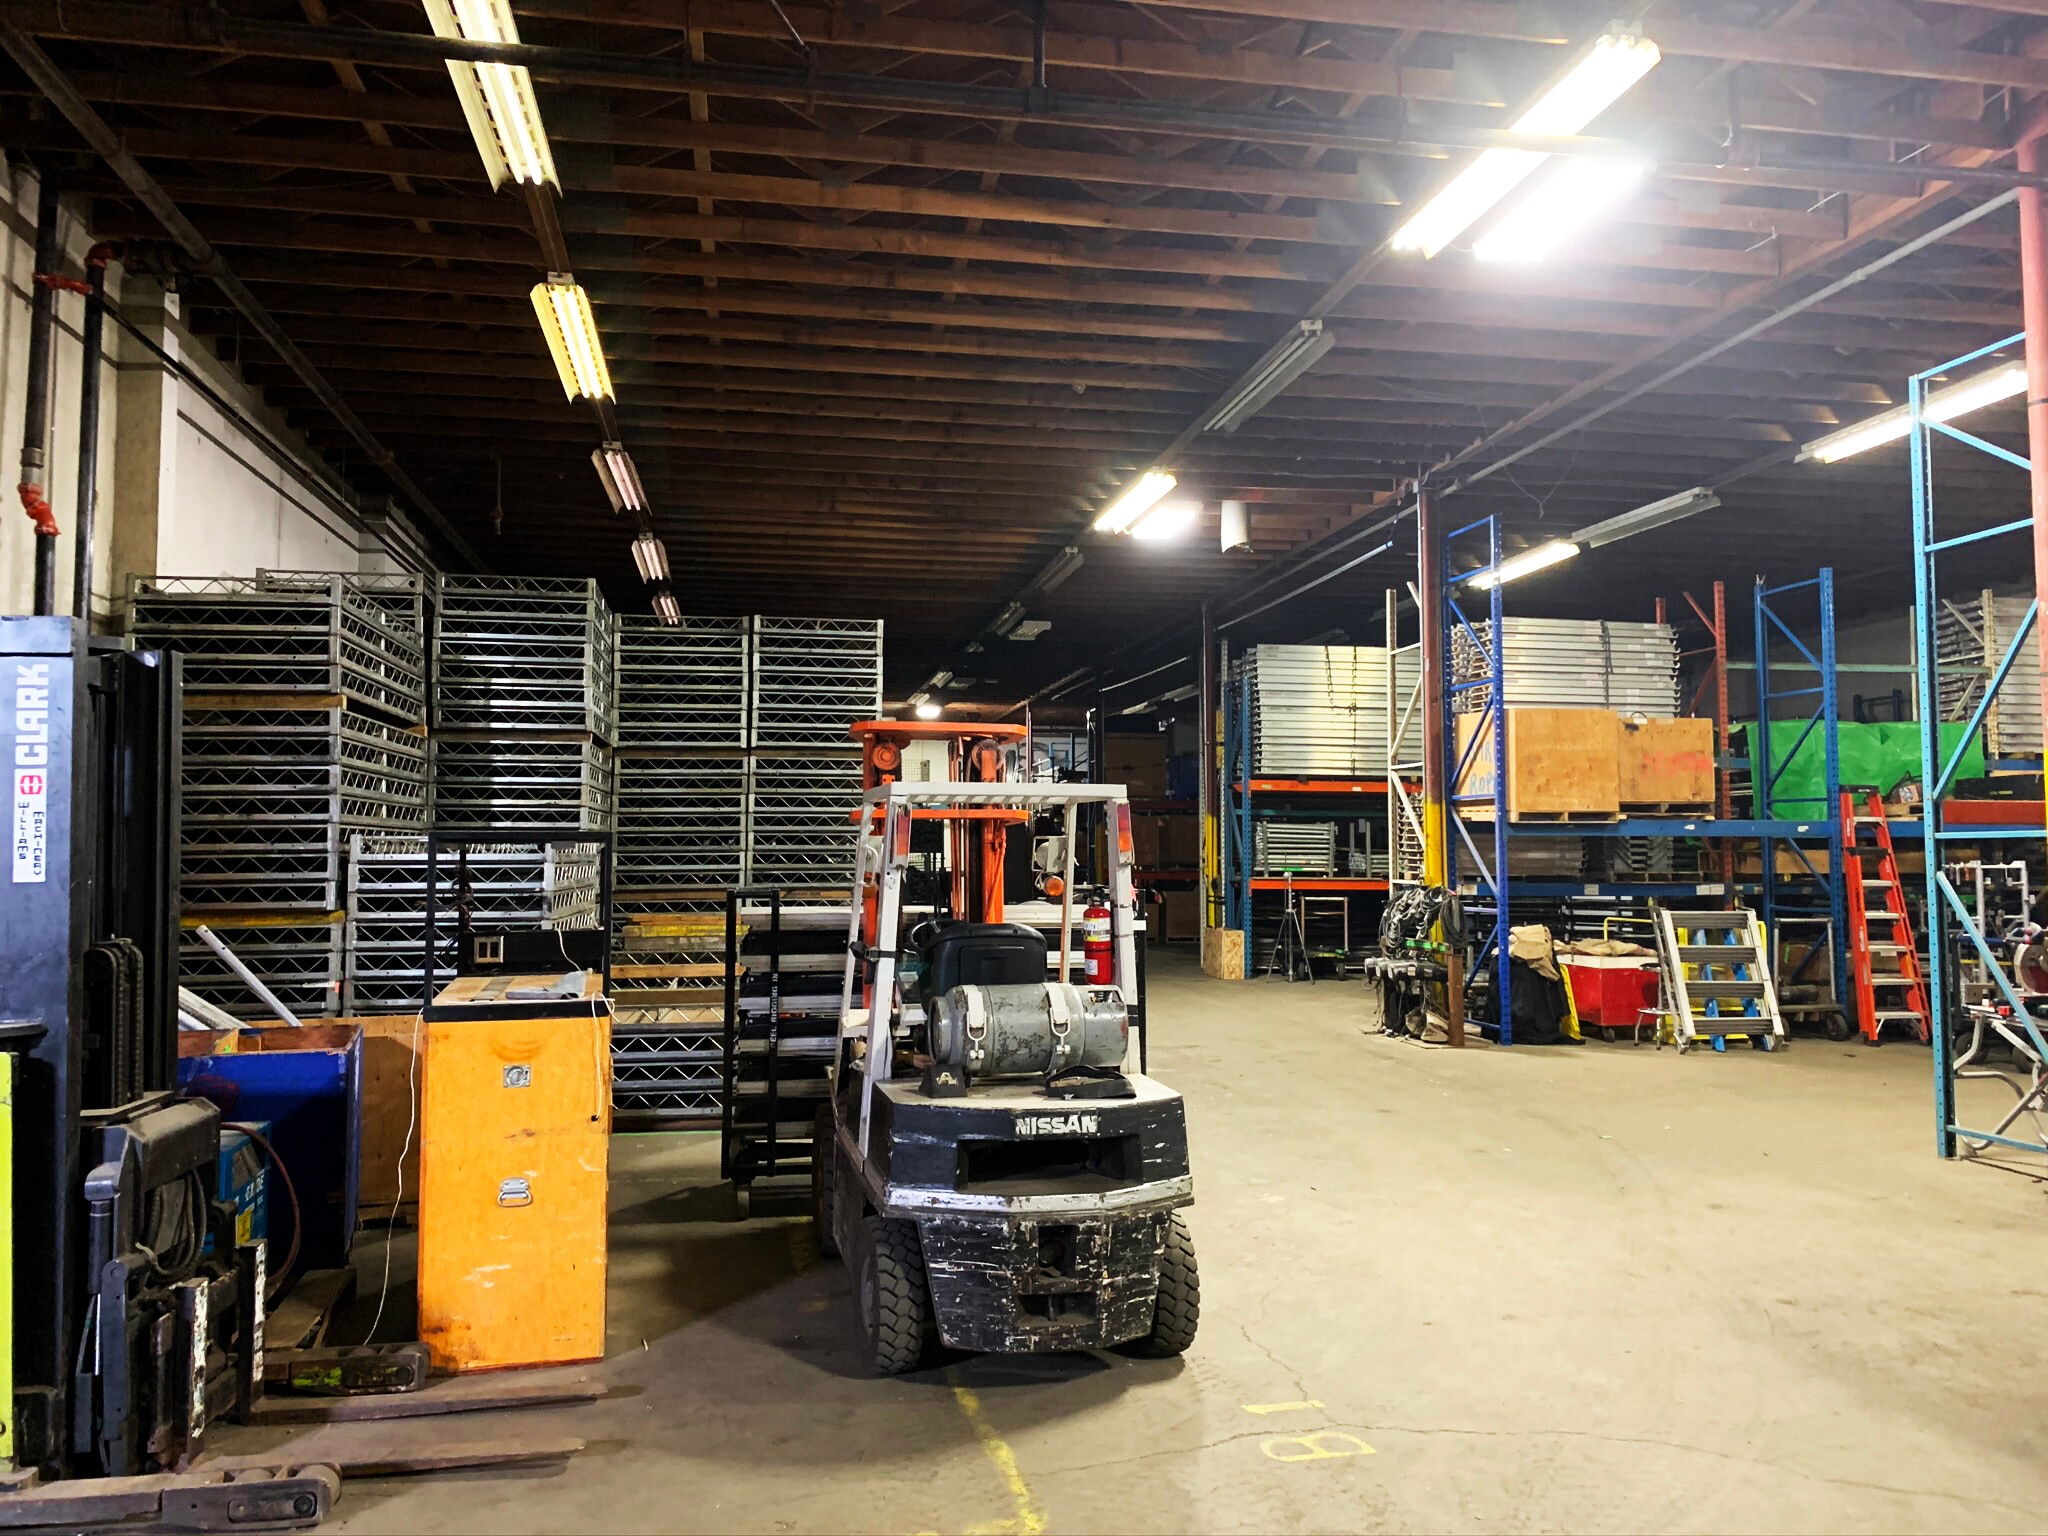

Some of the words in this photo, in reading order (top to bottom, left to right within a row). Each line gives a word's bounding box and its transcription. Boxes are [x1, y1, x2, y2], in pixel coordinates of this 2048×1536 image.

[15, 663, 49, 765] CLARK
[17, 801, 30, 860] WILLIAMS
[32, 811, 45, 876] MACHINERY
[770, 986, 778, 1023] RIGGING
[1016, 1115, 1098, 1135] NISSAN
